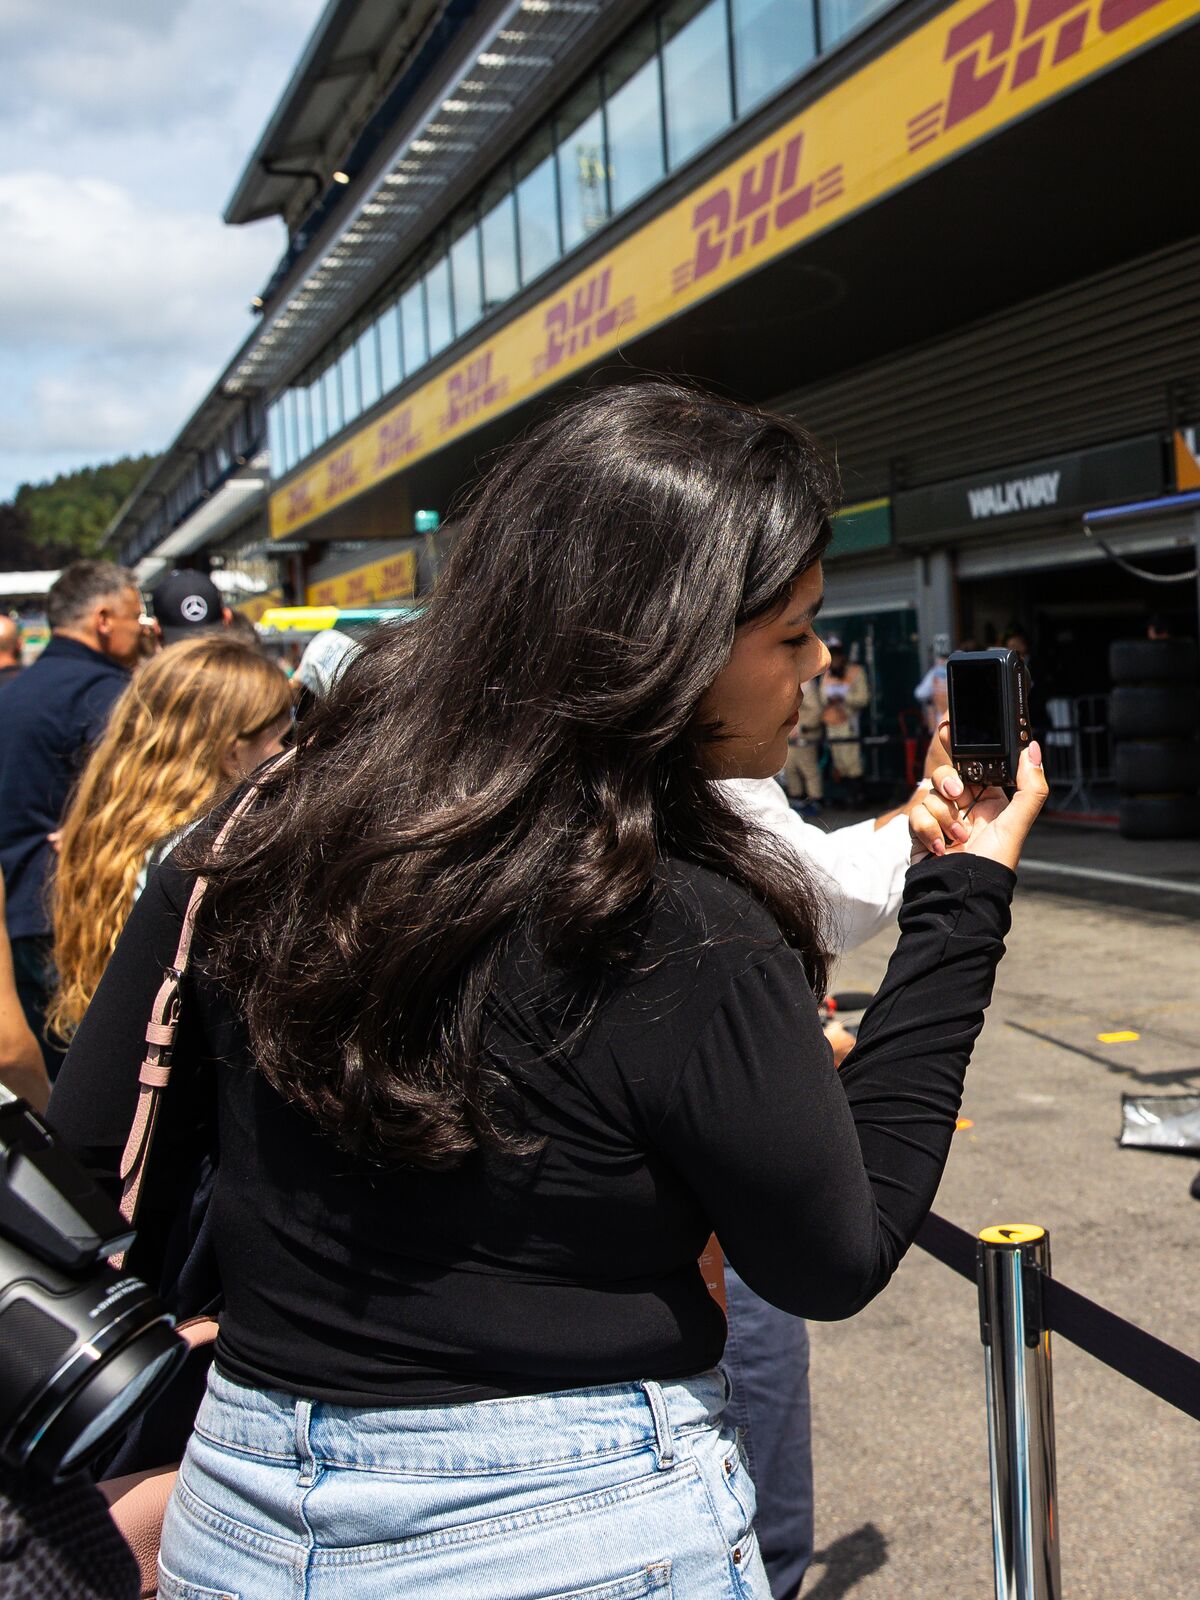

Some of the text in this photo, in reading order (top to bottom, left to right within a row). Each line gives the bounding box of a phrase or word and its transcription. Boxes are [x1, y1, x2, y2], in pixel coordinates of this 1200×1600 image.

[691, 129, 815, 283] DHL
[545, 265, 619, 371] DHL
[967, 470, 1061, 519] WALKWAY
